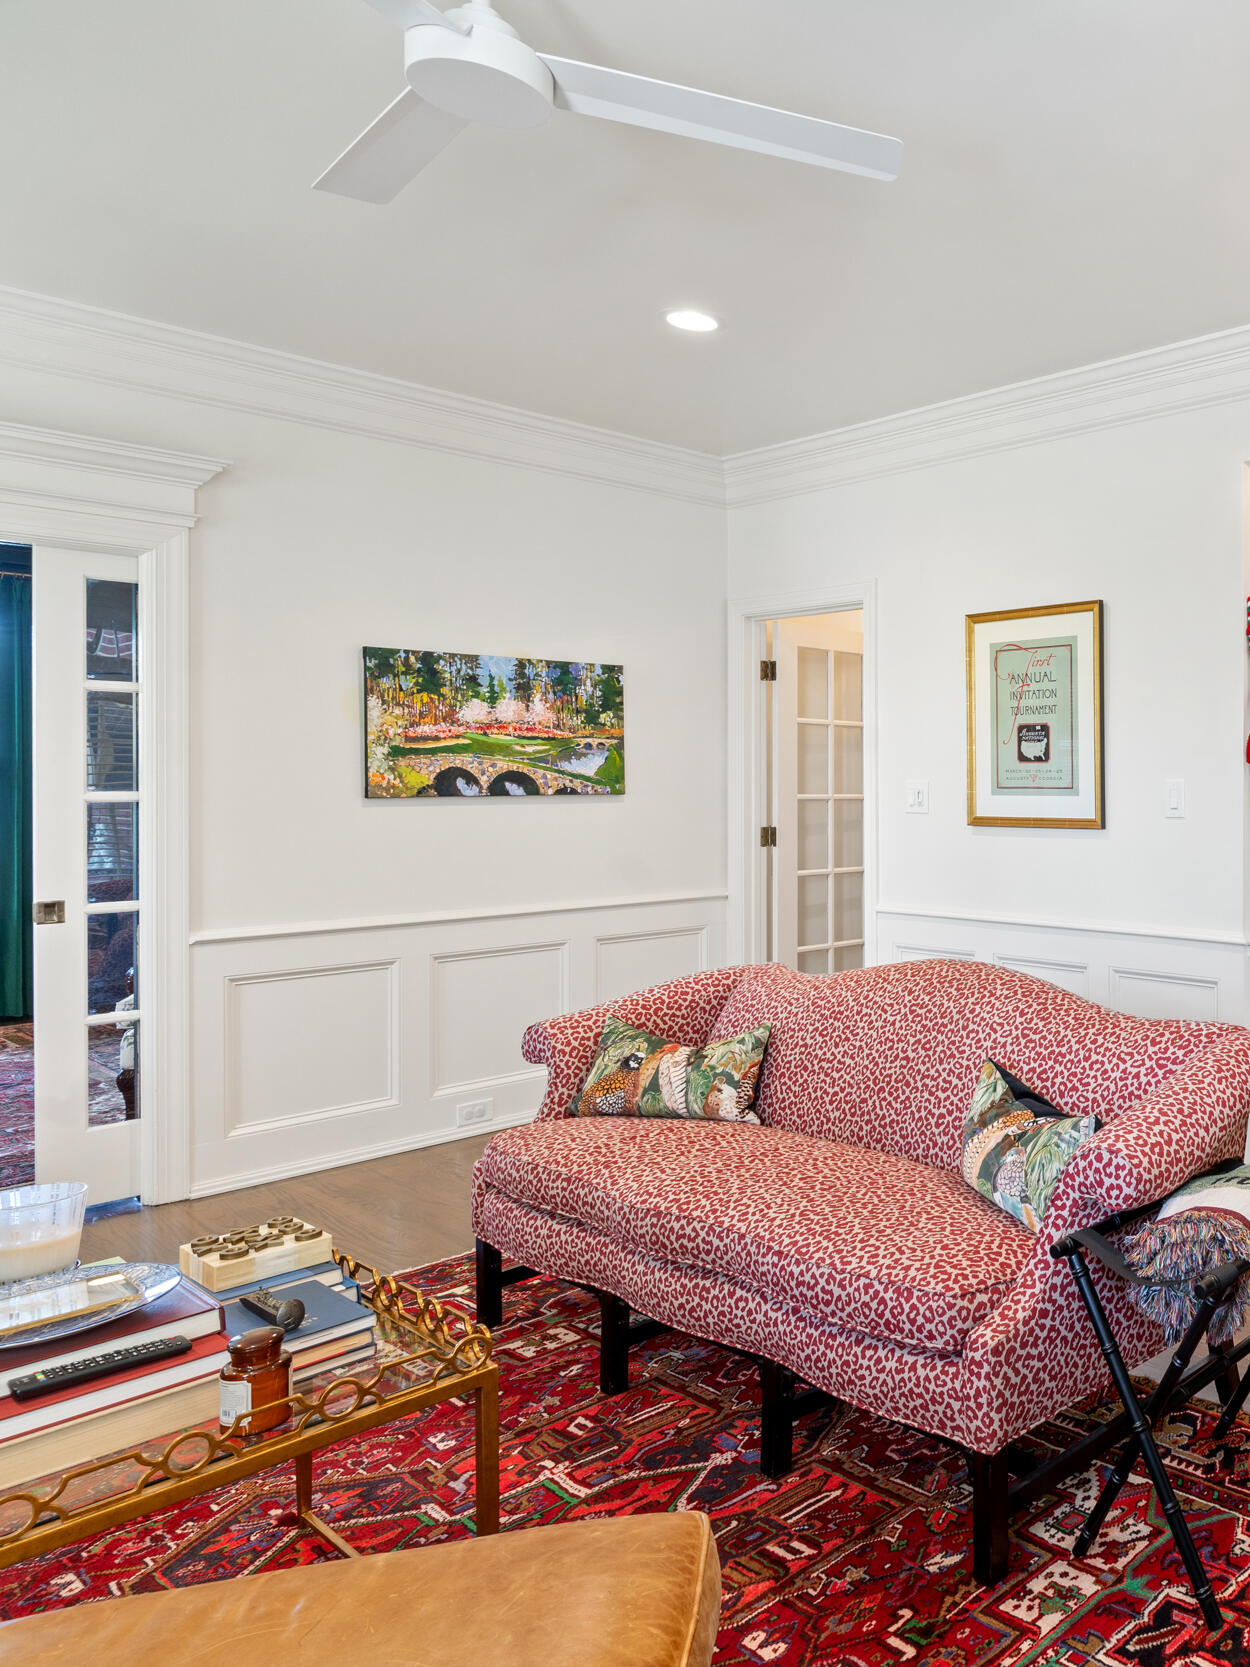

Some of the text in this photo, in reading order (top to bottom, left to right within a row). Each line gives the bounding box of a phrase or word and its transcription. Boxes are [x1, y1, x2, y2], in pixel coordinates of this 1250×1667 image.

[1010, 672, 1056, 684] ANNUAL
[1010, 688, 1057, 700] INVITATION
[1011, 704, 1057, 716] TOURNAMENT
